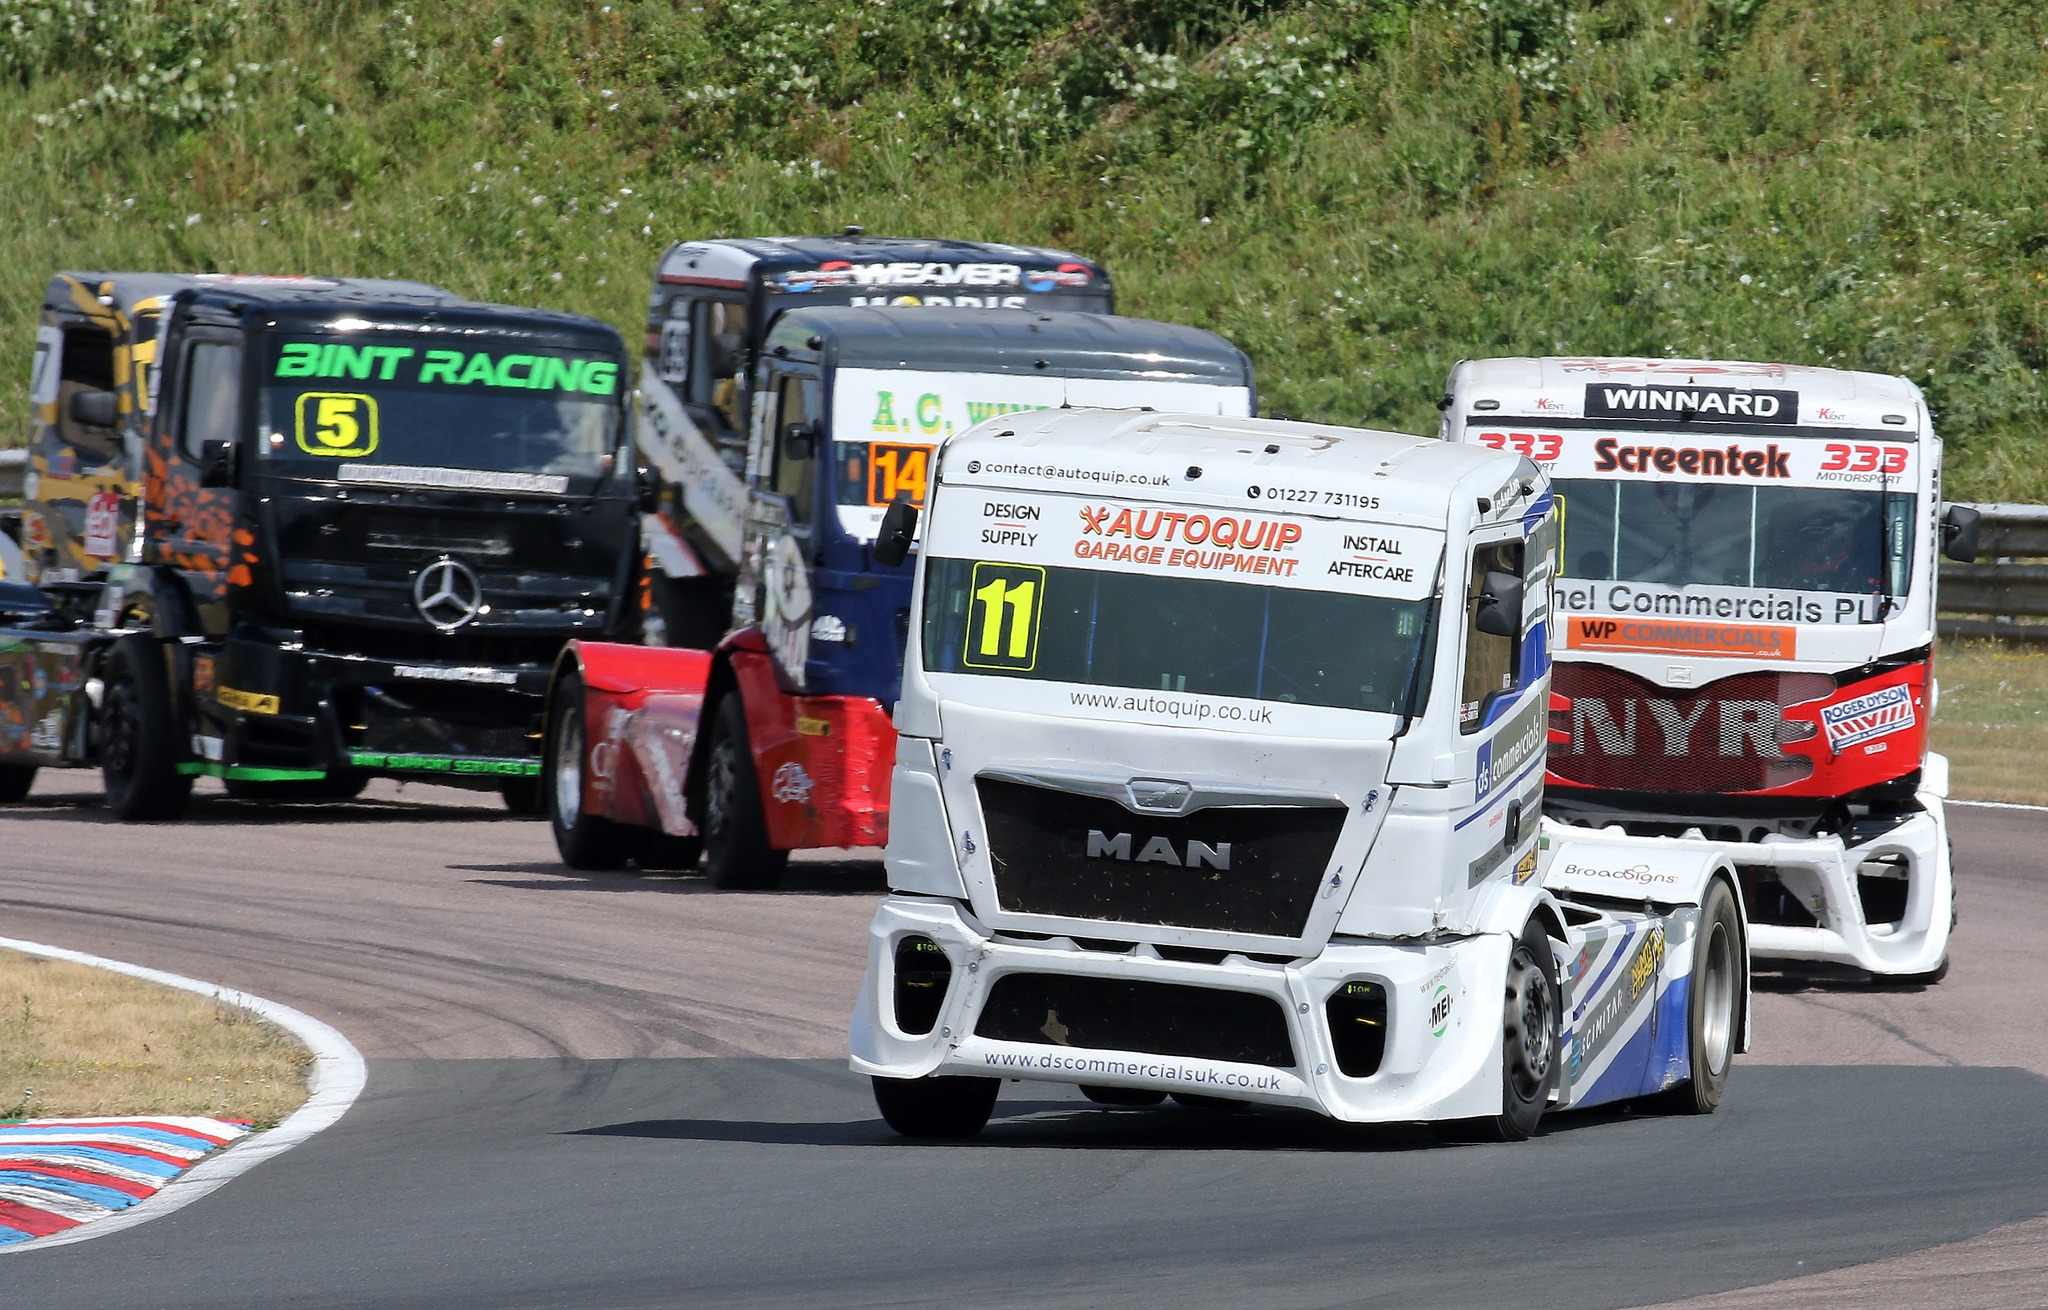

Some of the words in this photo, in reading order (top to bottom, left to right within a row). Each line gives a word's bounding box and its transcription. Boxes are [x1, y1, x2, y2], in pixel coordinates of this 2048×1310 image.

[852, 262, 1022, 286] WEAVER
[274, 343, 415, 381] BINT
[418, 350, 620, 396] RACING
[1603, 388, 1781, 417] WINNARD
[315, 398, 360, 448] 5
[875, 450, 927, 500] 14
[985, 462, 1171, 487] contact@autoquip.co.uk
[1594, 437, 1791, 479] Screentek
[1820, 443, 1910, 474] 333
[1815, 471, 1903, 485] MOTORSPORT
[983, 502, 1041, 521] DESIGN
[1266, 488, 1317, 504] 01227
[1323, 491, 1381, 510] 731195
[981, 529, 1040, 548] SUPPLY
[1106, 507, 1303, 552] AUTOQUIP
[1343, 534, 1402, 555] INSTALL
[1074, 539, 1164, 566] GARAGE
[1167, 547, 1299, 578] EQUIPMENT
[1327, 561, 1415, 584] AFTERCARE
[976, 578, 1036, 659] 11
[1608, 584, 1823, 623] Commercials
[1581, 620, 1617, 640] WP
[1622, 622, 1782, 648] COMMERCIALS
[1755, 648, 1783, 657] .co.uk
[1070, 691, 1273, 724] www.autoquip.co.uk
[1823, 700, 1866, 725] ROGER
[1866, 685, 1909, 708] DYSON
[1572, 697, 1783, 758] NYR
[1477, 762, 1489, 795] ds
[1492, 716, 1540, 783] commercials
[1086, 829, 1232, 871] MAN
[1431, 993, 1451, 1029] MEI
[1581, 988, 1623, 1057] SCIMITAR
[984, 1052, 1282, 1091] www.dscommercialsuk.co.uk
